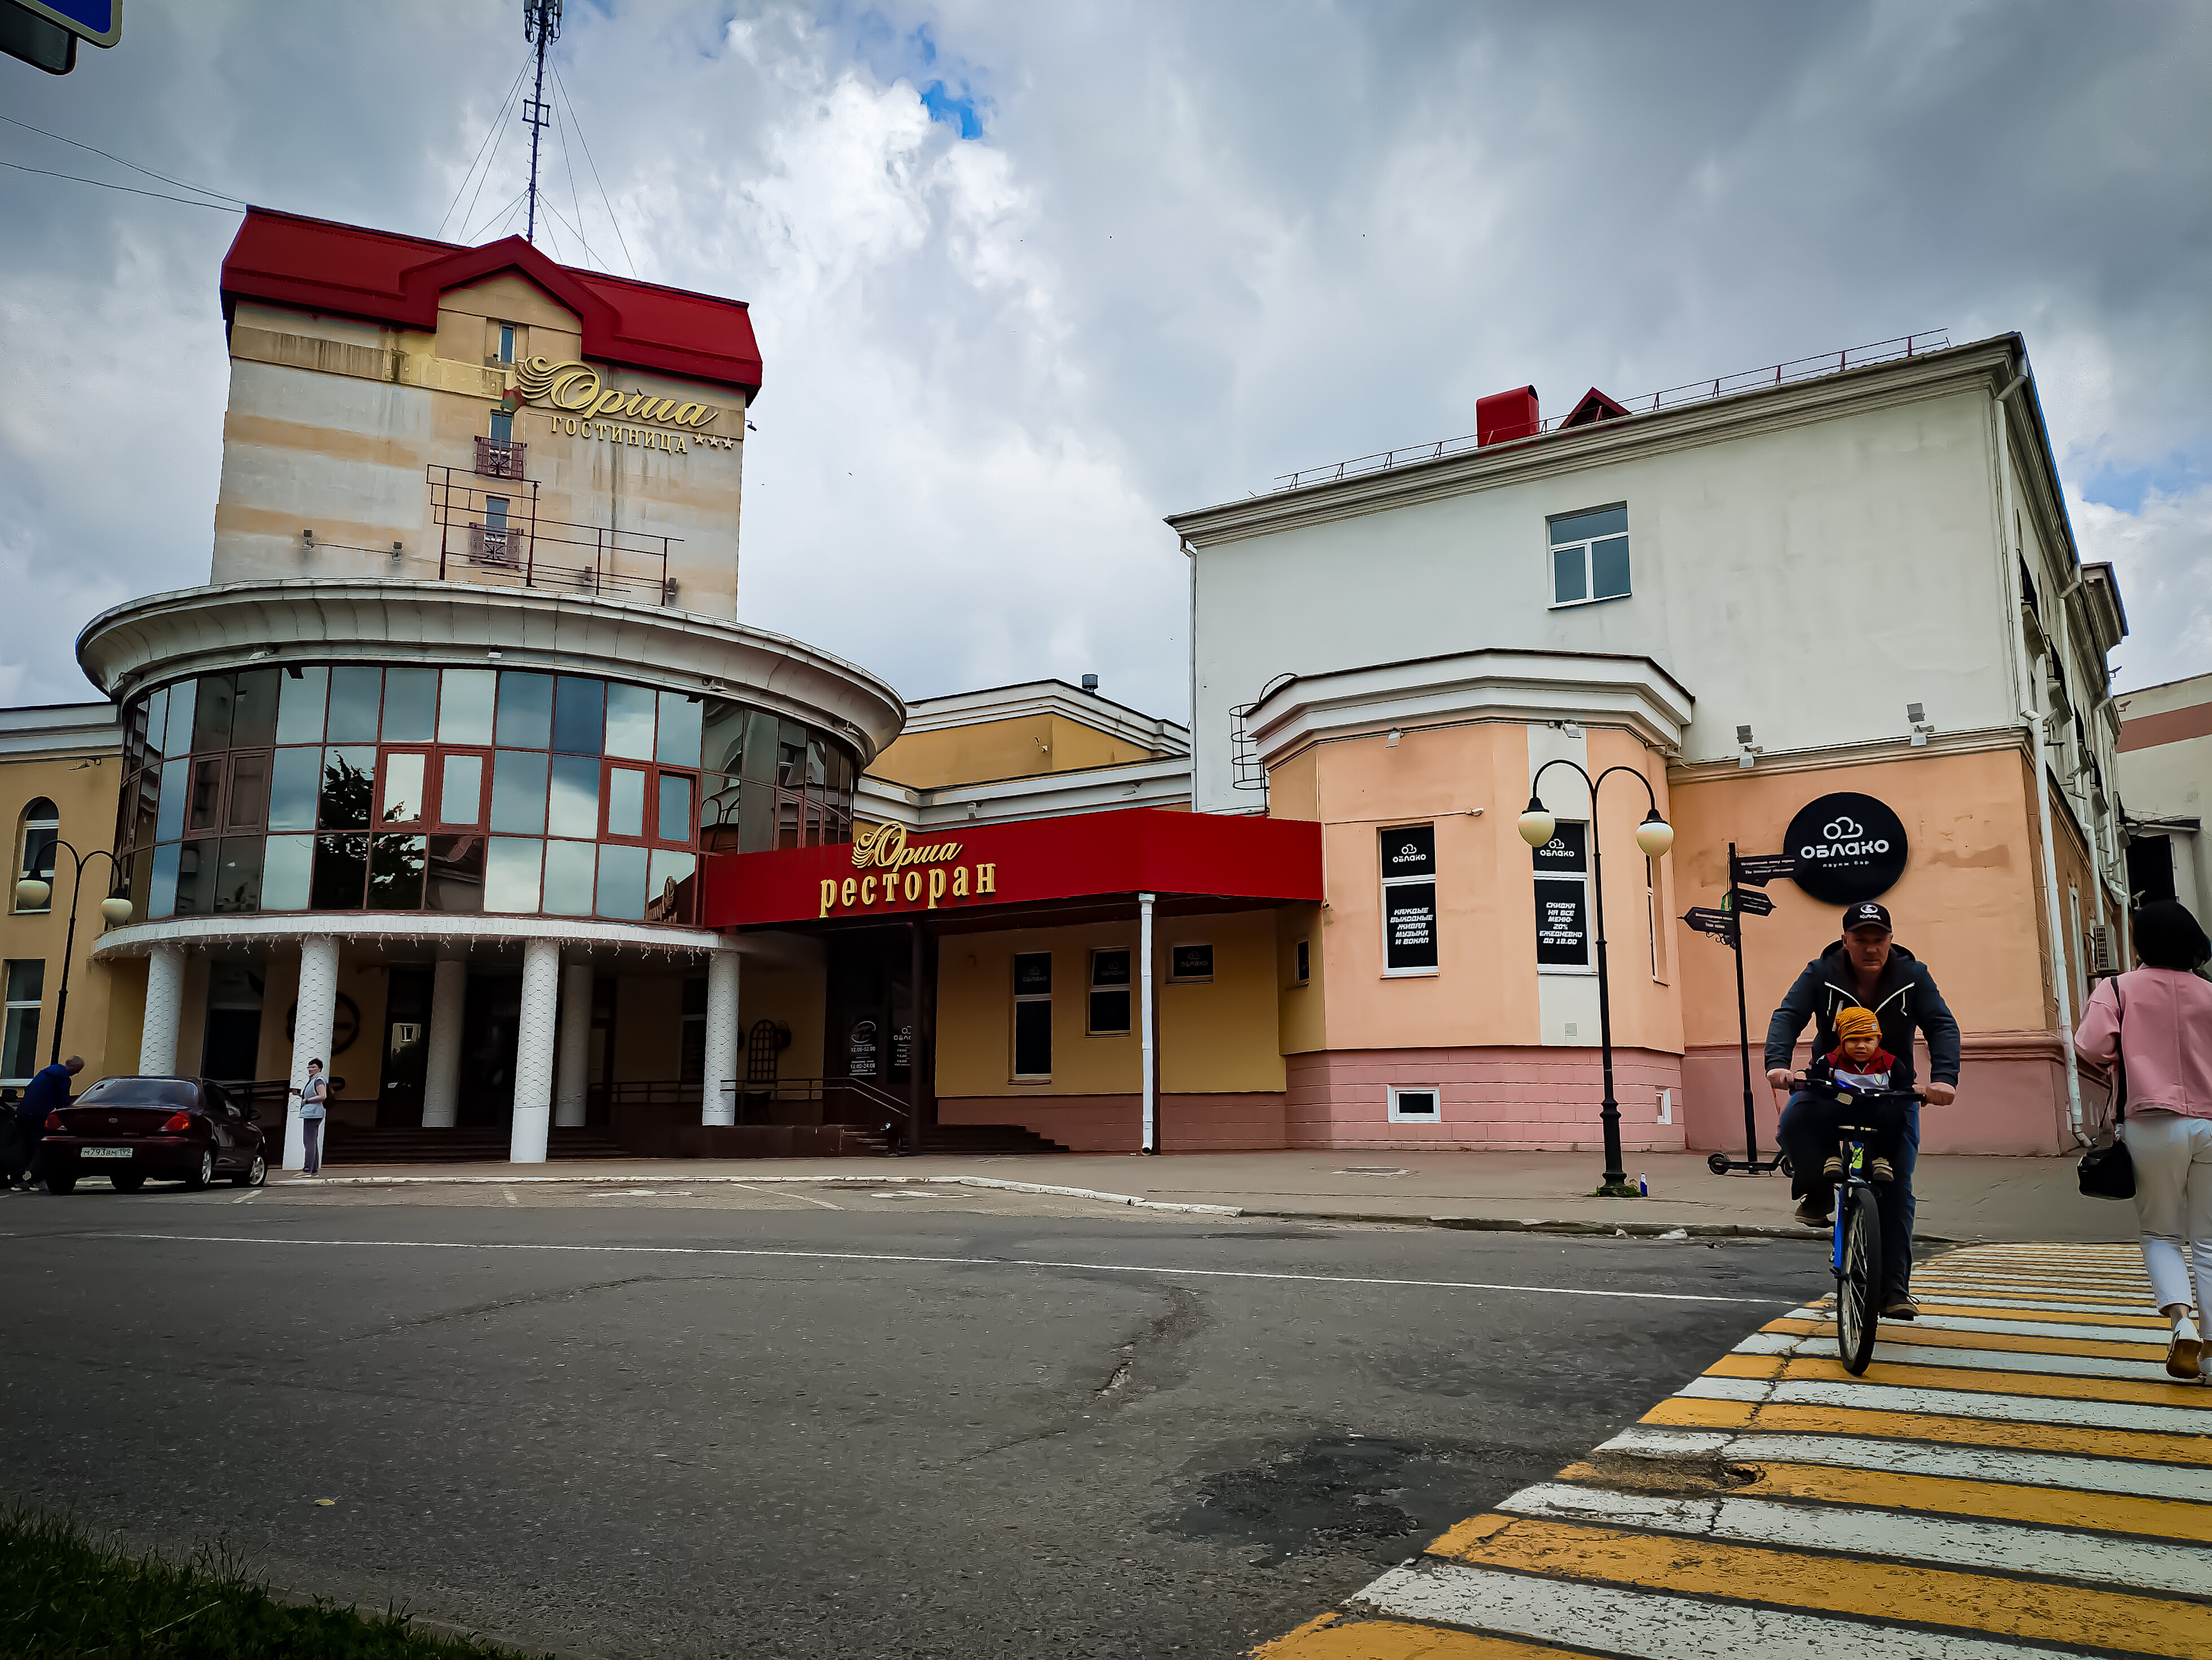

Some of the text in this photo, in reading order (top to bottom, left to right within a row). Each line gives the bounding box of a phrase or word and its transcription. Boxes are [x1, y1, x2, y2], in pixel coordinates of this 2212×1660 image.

[517, 356, 718, 427] Орша
[551, 416, 688, 455] ГОСТИНИЦА
[852, 821, 963, 872] Орша
[819, 863, 996, 918] ресторан
[1390, 914, 1433, 923] ВЫХОДНЫЕ
